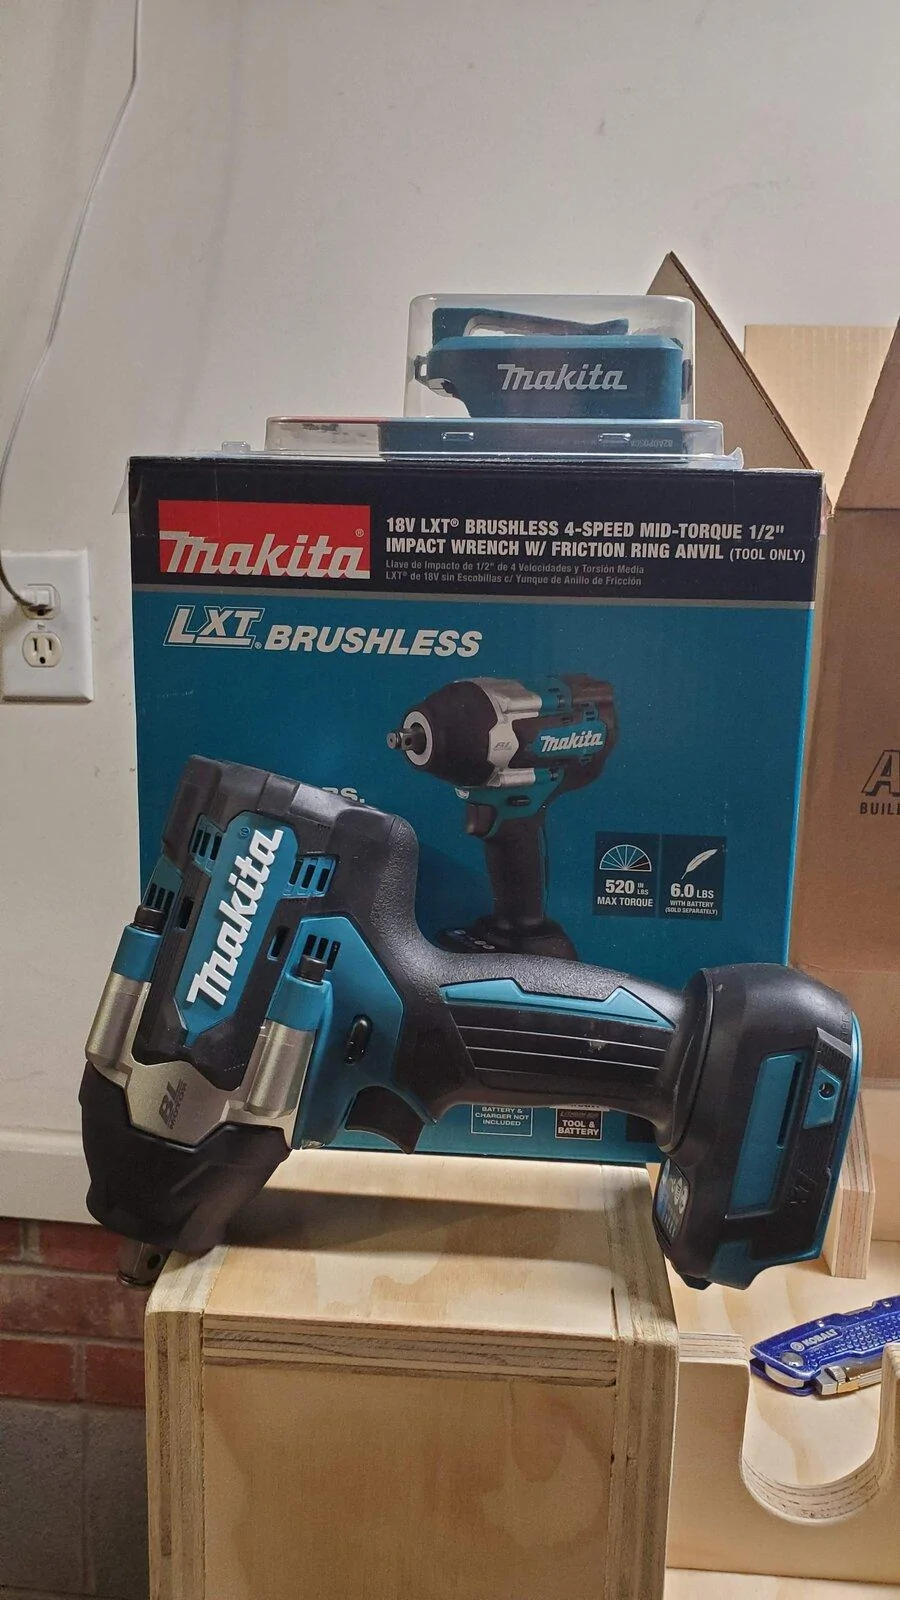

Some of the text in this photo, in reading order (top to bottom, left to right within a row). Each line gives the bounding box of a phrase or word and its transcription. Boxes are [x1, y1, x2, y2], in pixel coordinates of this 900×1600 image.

[498, 363, 627, 391] Makita
[386, 517, 416, 533] 18V
[465, 519, 559, 536] BRUSHLESS
[564, 521, 634, 538] 4-SPEED
[640, 522, 742, 540] MID-TORQUE
[749, 524, 785, 540] 1/2"
[159, 530, 370, 579] Makita
[386, 537, 806, 563] IMPACT WRENCH W/ FRICTION RING ANVIL (TOOL ONLY)
[386, 559, 644, 574] Llave de Impacto de 1/2" de 4 Velocidades y Torsión Media
[410, 572, 421, 581] de
[424, 572, 439, 581] 18V
[442, 572, 454, 582] sin
[458, 573, 501, 583] Escobillas
[504, 573, 514, 583] c/
[516, 574, 548, 585] Yunque
[551, 574, 562, 584] de
[564, 575, 590, 585] Anillo
[592, 575, 603, 585] de
[605, 575, 642, 586] Fricción
[264, 624, 482, 658] BRUSHLESS
[541, 730, 603, 753] Makita
[605, 879, 635, 894] 520
[670, 883, 714, 899] 6.0 LBS
[597, 896, 653, 907] MAX TORQUE
[186, 829, 283, 1006] Makita
[682, 907, 718, 916] SEPARATELY)
[557, 1127, 599, 1136] BATTERY
[562, 1119, 586, 1128] TOOL
